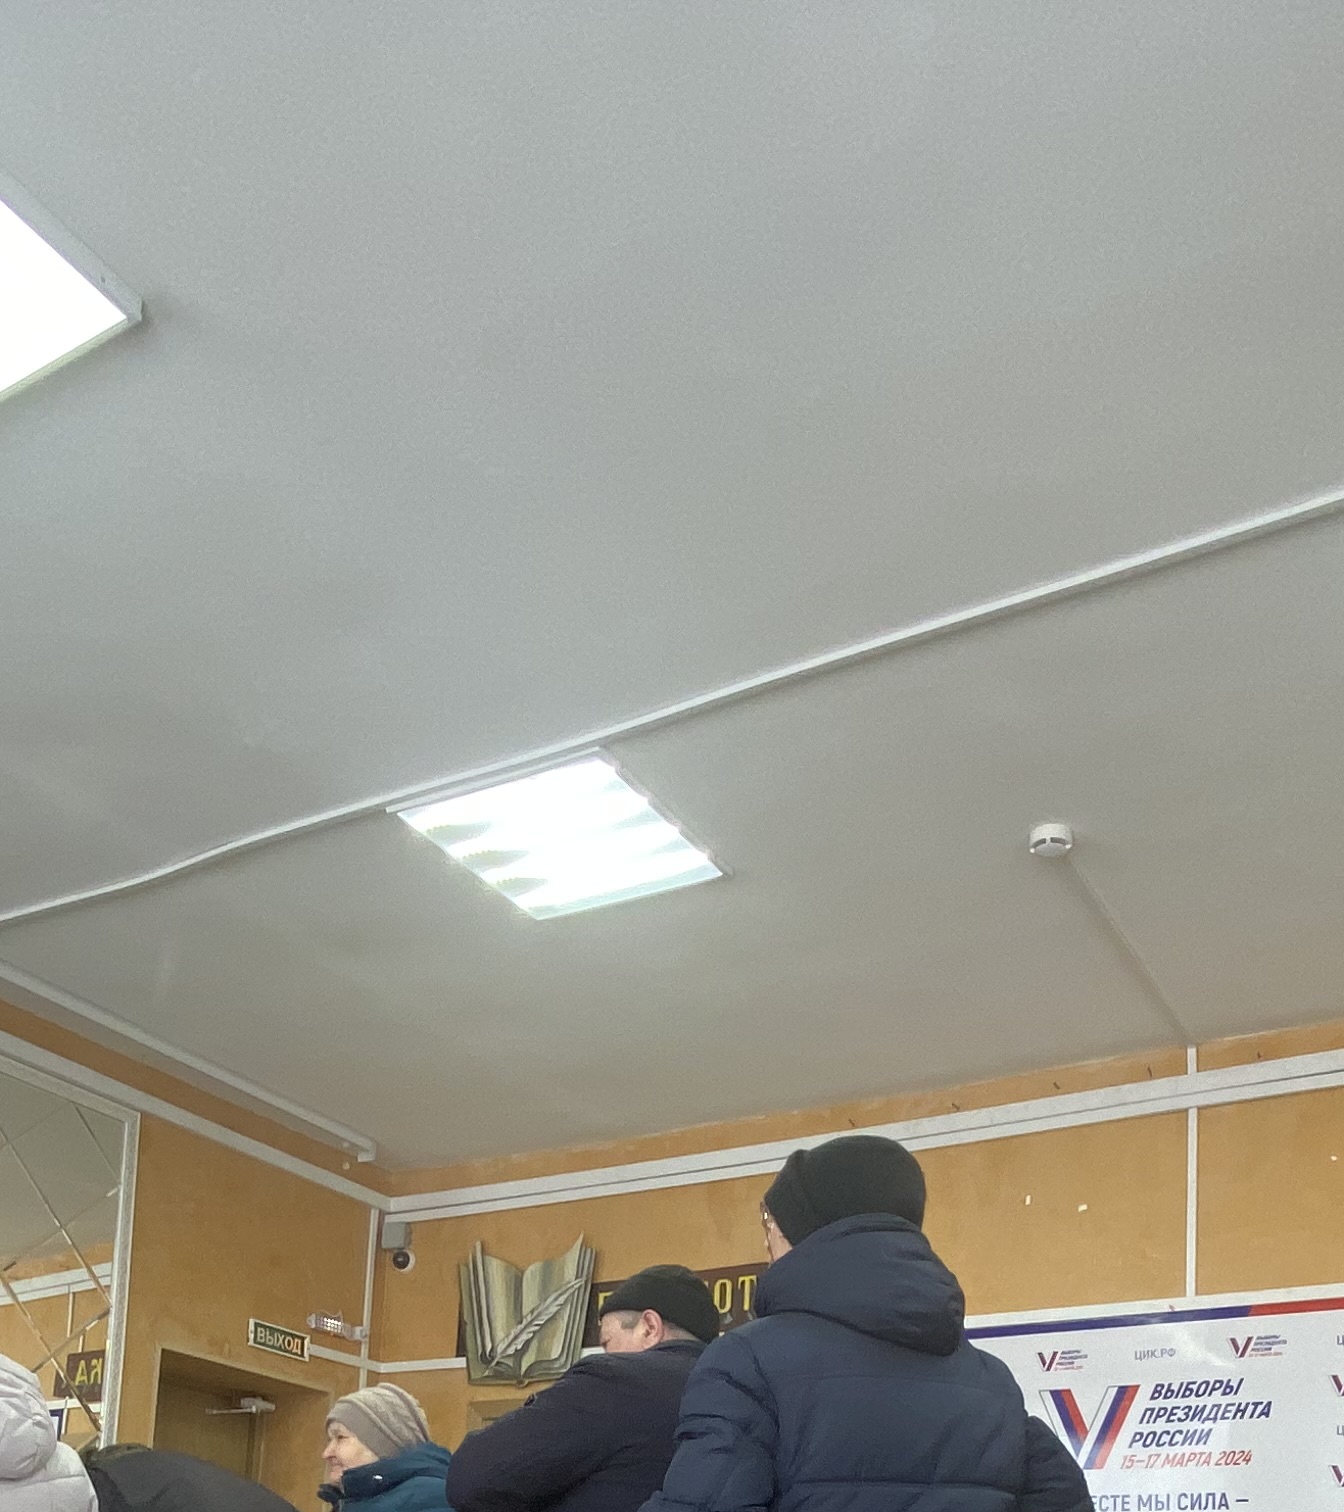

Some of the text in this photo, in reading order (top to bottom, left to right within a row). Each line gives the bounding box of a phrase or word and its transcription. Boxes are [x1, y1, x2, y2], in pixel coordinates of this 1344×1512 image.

[256, 1326, 302, 1355] ВЫХОД
[1134, 1348, 1176, 1361] ЦИК.РФ
[1149, 1377, 1245, 1401] ВЫБОРЫ
[1138, 1401, 1273, 1425] ПРЕЗИДЕНТА
[1128, 1428, 1213, 1449] РОССИИ
[1162, 1451, 1212, 1468] МАРТА
[1215, 1449, 1253, 1466] 2024
[1092, 1494, 1131, 1512] ЕСТЕ
[1137, 1493, 1171, 1511] МЫ
[1177, 1492, 1230, 1510] СИЛА
